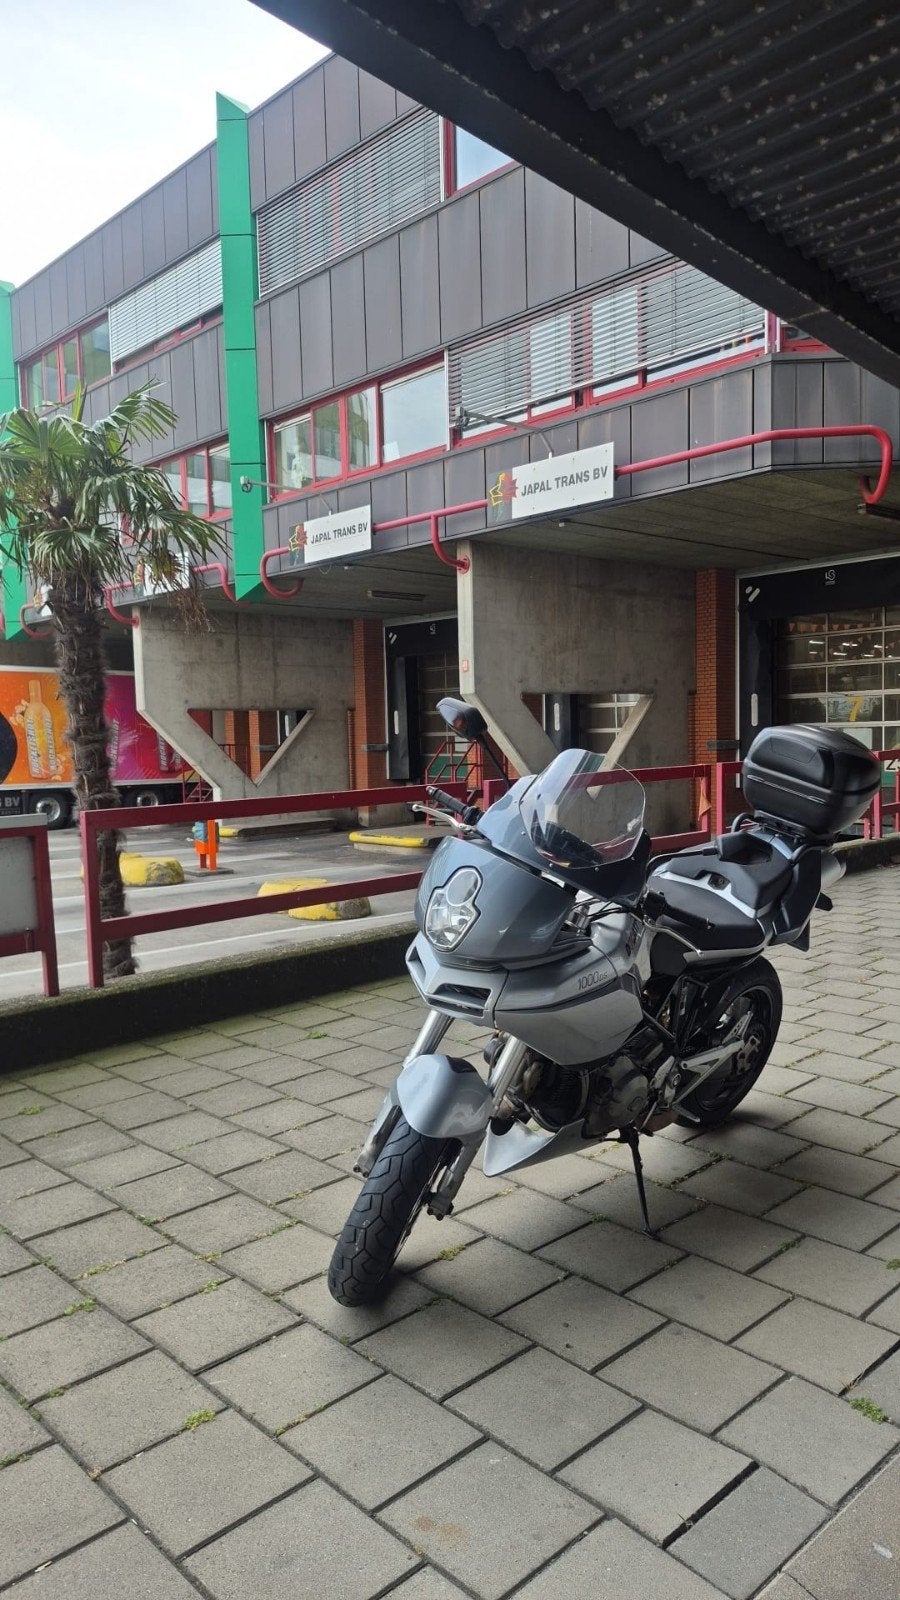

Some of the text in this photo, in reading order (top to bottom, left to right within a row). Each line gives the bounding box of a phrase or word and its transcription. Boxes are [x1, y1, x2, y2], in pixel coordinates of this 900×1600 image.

[521, 465, 608, 497] JAPAL TRANS BV
[310, 522, 368, 545] JAPAL TRANS BV
[5, 796, 20, 807] BV
